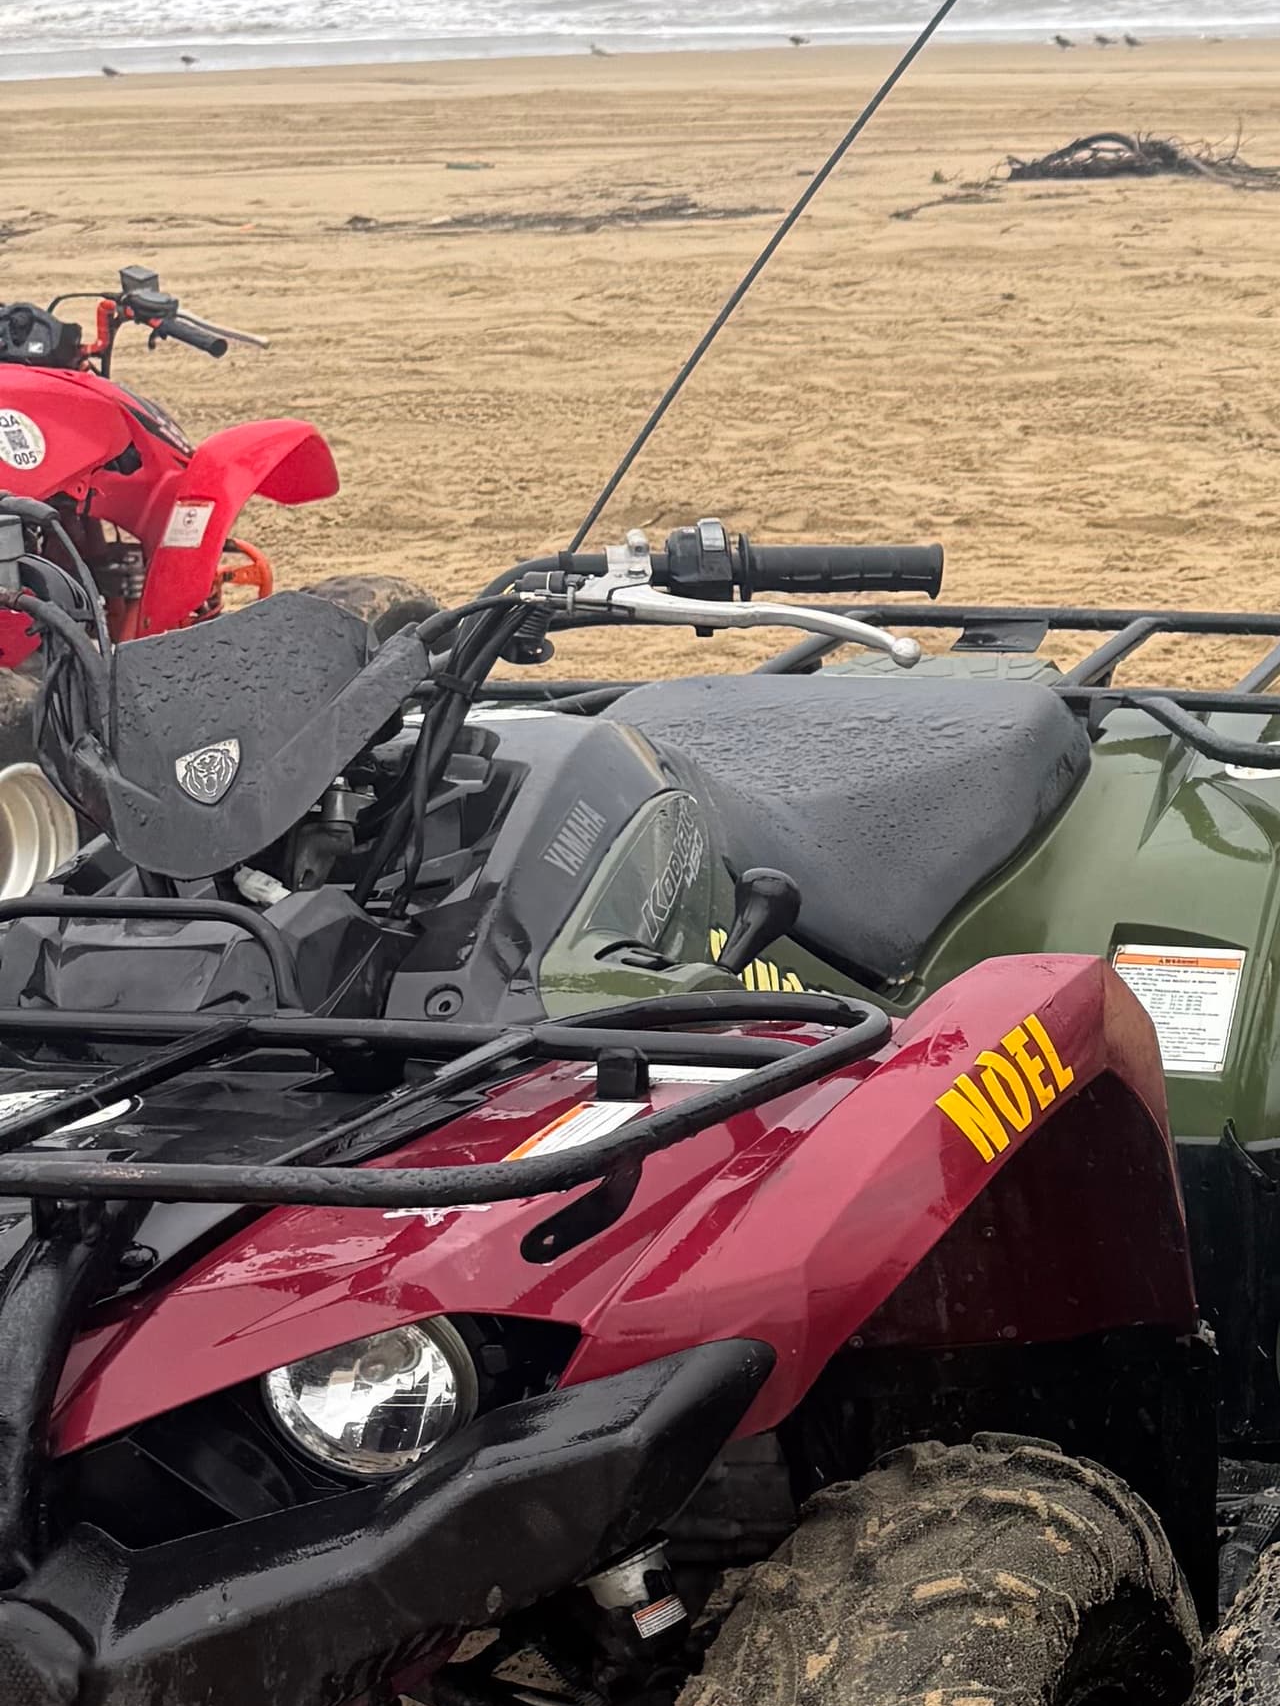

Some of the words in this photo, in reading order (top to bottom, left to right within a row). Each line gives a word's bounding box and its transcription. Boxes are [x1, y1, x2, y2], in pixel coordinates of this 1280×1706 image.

[14, 450, 38, 465] 005
[543, 799, 607, 877] YAMAHA
[935, 1013, 1075, 1164] NOEL
